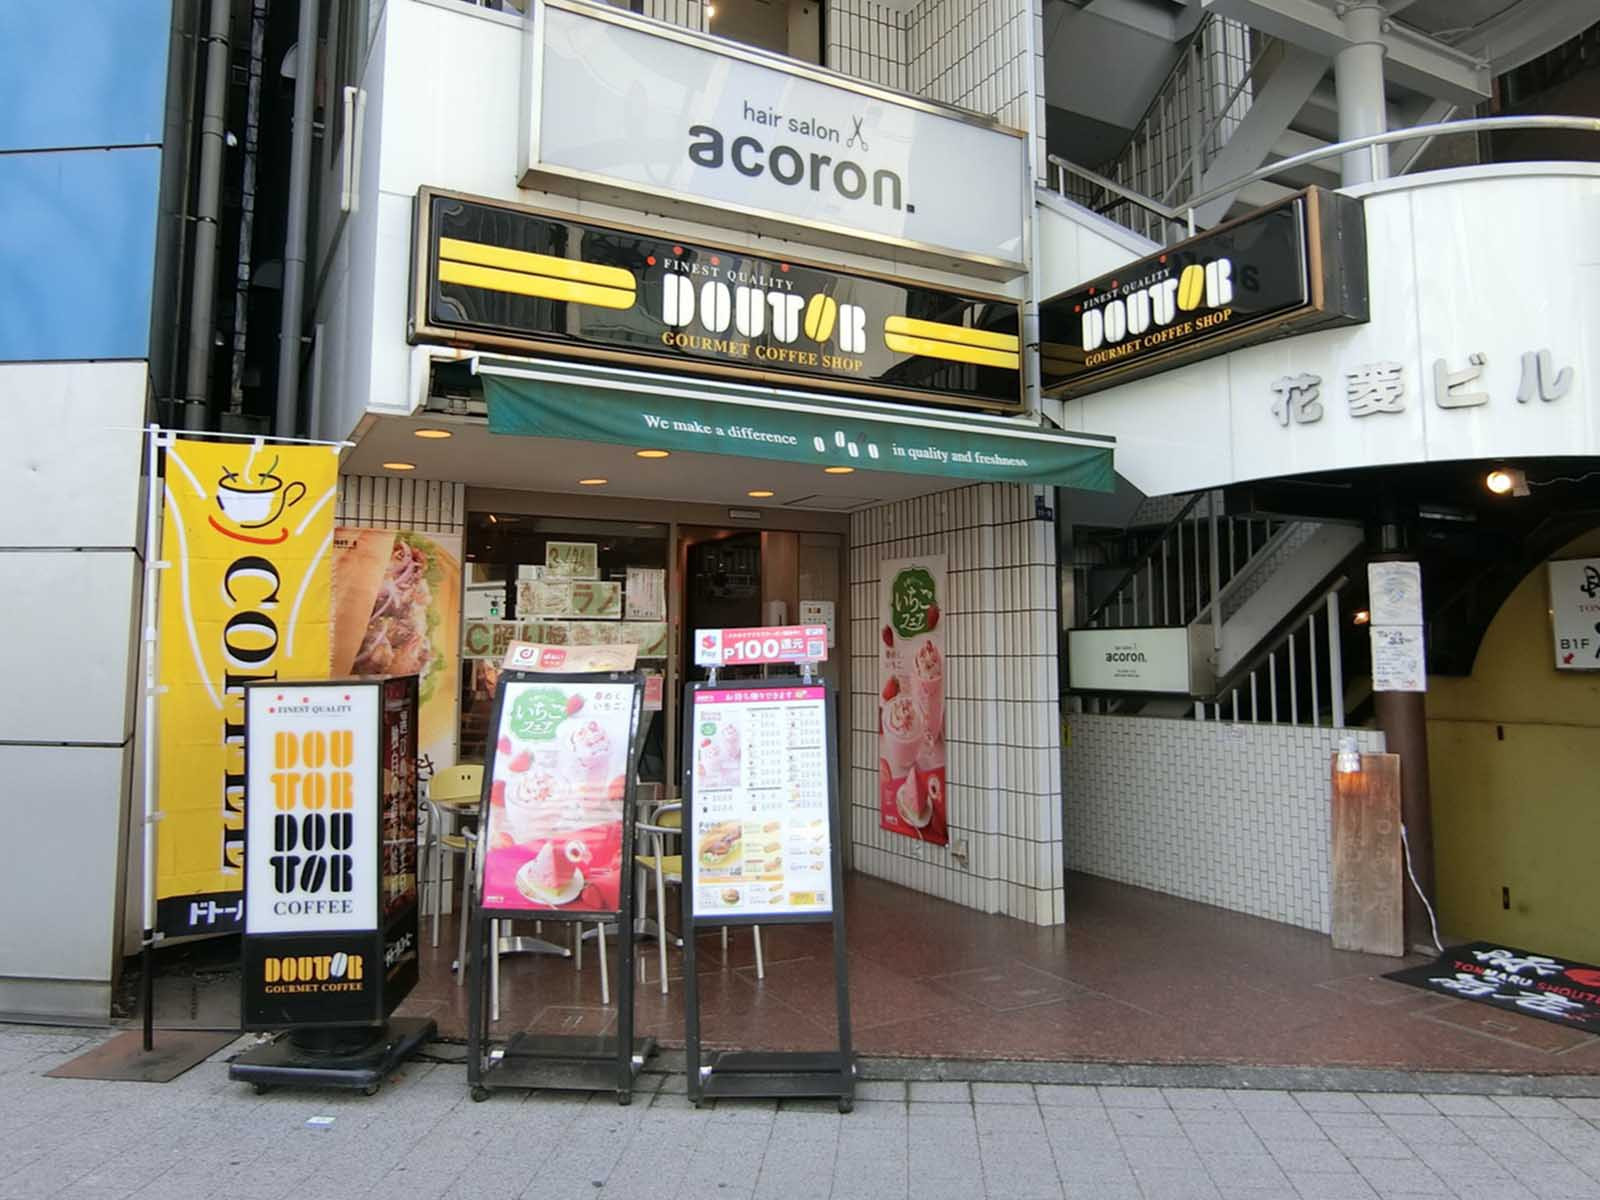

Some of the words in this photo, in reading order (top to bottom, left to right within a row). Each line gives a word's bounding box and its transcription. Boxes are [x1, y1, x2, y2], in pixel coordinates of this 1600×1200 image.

[743, 100, 782, 128] hair
[787, 115, 841, 144] salon
[688, 124, 915, 214] acoron.
[663, 257, 721, 277] FINEST
[726, 269, 795, 291] QUALITY
[1083, 287, 1119, 310] FINEST
[1122, 268, 1171, 293] QUALITY
[662, 273, 866, 354] DOUTOR
[1081, 258, 1232, 352] DOUTOR
[661, 330, 751, 359] GOURMET
[754, 343, 819, 367] COFFEE
[821, 352, 864, 373] SHOP
[1084, 339, 1143, 367] GOURMET
[1143, 321, 1194, 347] COFFEE
[1194, 309, 1233, 330] SHOP
[1271, 349, 1575, 428] 花菱ビル
[643, 414, 670, 430] We
[672, 417, 713, 435] make
[715, 425, 726, 436] a
[727, 424, 798, 446] difference
[892, 443, 906, 457] in
[907, 445, 949, 464] quality
[951, 449, 973, 464] and
[974, 450, 1029, 468] freshness
[1560, 639, 1590, 650] B1F
[278, 706, 309, 714] FINEST
[312, 704, 352, 714] QUALITY
[274, 730, 354, 769] DOU
[269, 771, 354, 811] TOR
[274, 812, 353, 852] DOU
[269, 854, 354, 894] TOR
[273, 900, 353, 916] COFFEE
[264, 951, 363, 982] DOUTOR
[1453, 960, 1533, 987] TONMARU
[264, 983, 318, 994] GOURMET
[321, 982, 363, 992] COFFEE
